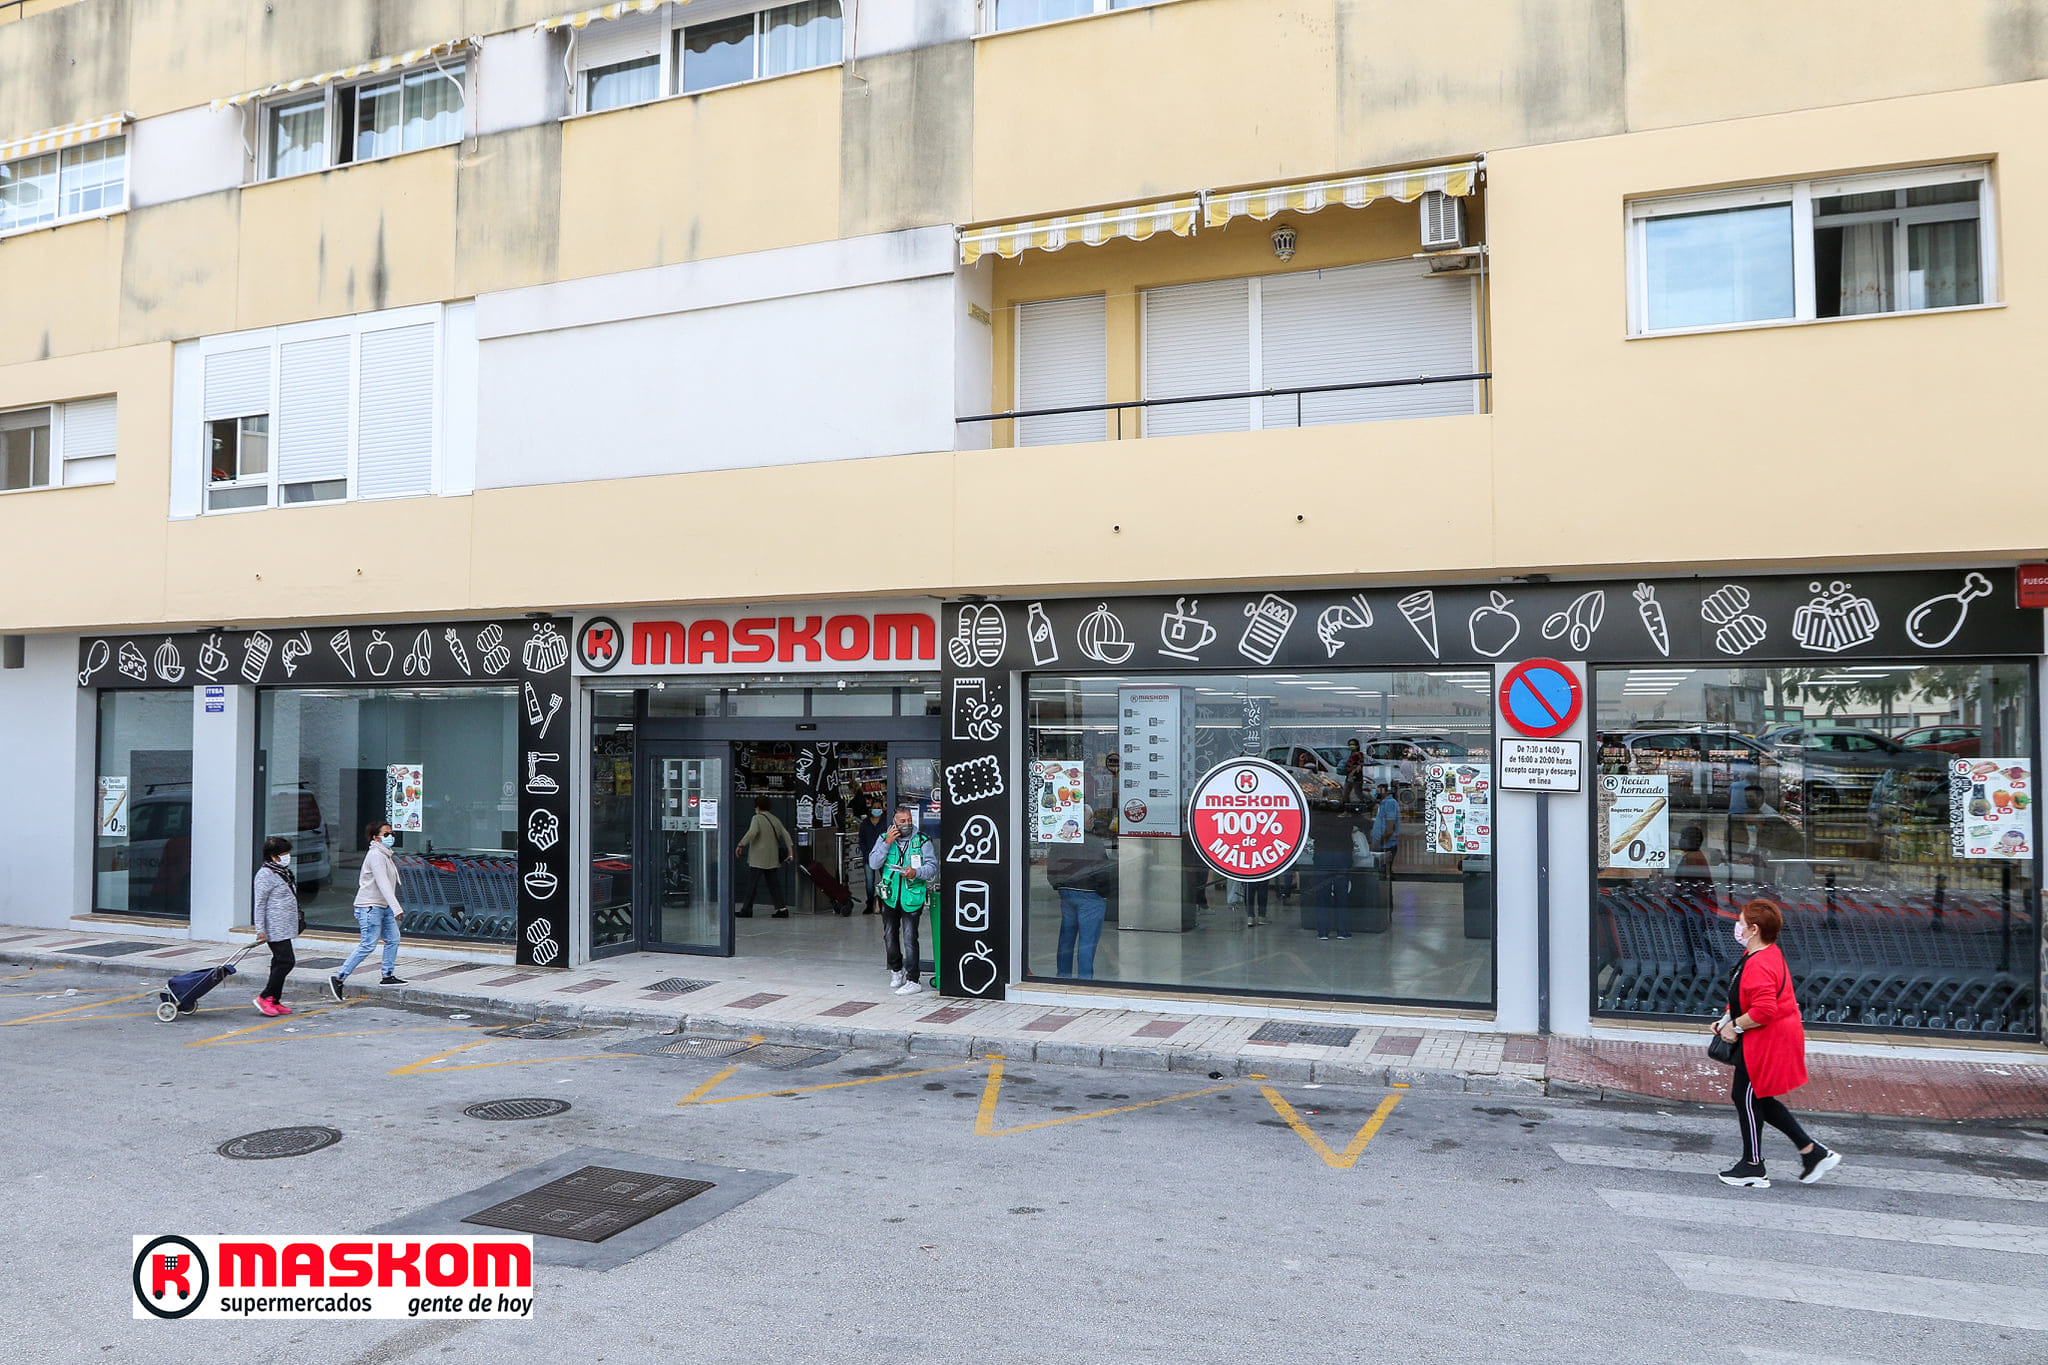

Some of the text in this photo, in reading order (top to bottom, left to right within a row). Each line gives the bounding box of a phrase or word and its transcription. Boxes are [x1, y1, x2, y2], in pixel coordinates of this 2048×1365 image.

[632, 613, 936, 665] MASKOM
[1517, 745, 1524, 753] De
[1526, 745, 1539, 753] 7:30
[1545, 746, 1560, 754] 14:00
[1510, 755, 1516, 763] de
[1540, 756, 1555, 764] 20:00
[1556, 757, 1572, 765] horas
[1528, 768, 1544, 776] carga
[1550, 767, 1577, 777] descarga
[1620, 776, 1650, 785] Recién
[1620, 785, 1664, 794] horneado
[1205, 795, 1290, 807] MASKOM
[1211, 810, 1283, 836] 100%
[1242, 836, 1257, 847] de
[1208, 838, 1292, 869] MÁLAGA
[1629, 839, 1666, 864] 0,29
